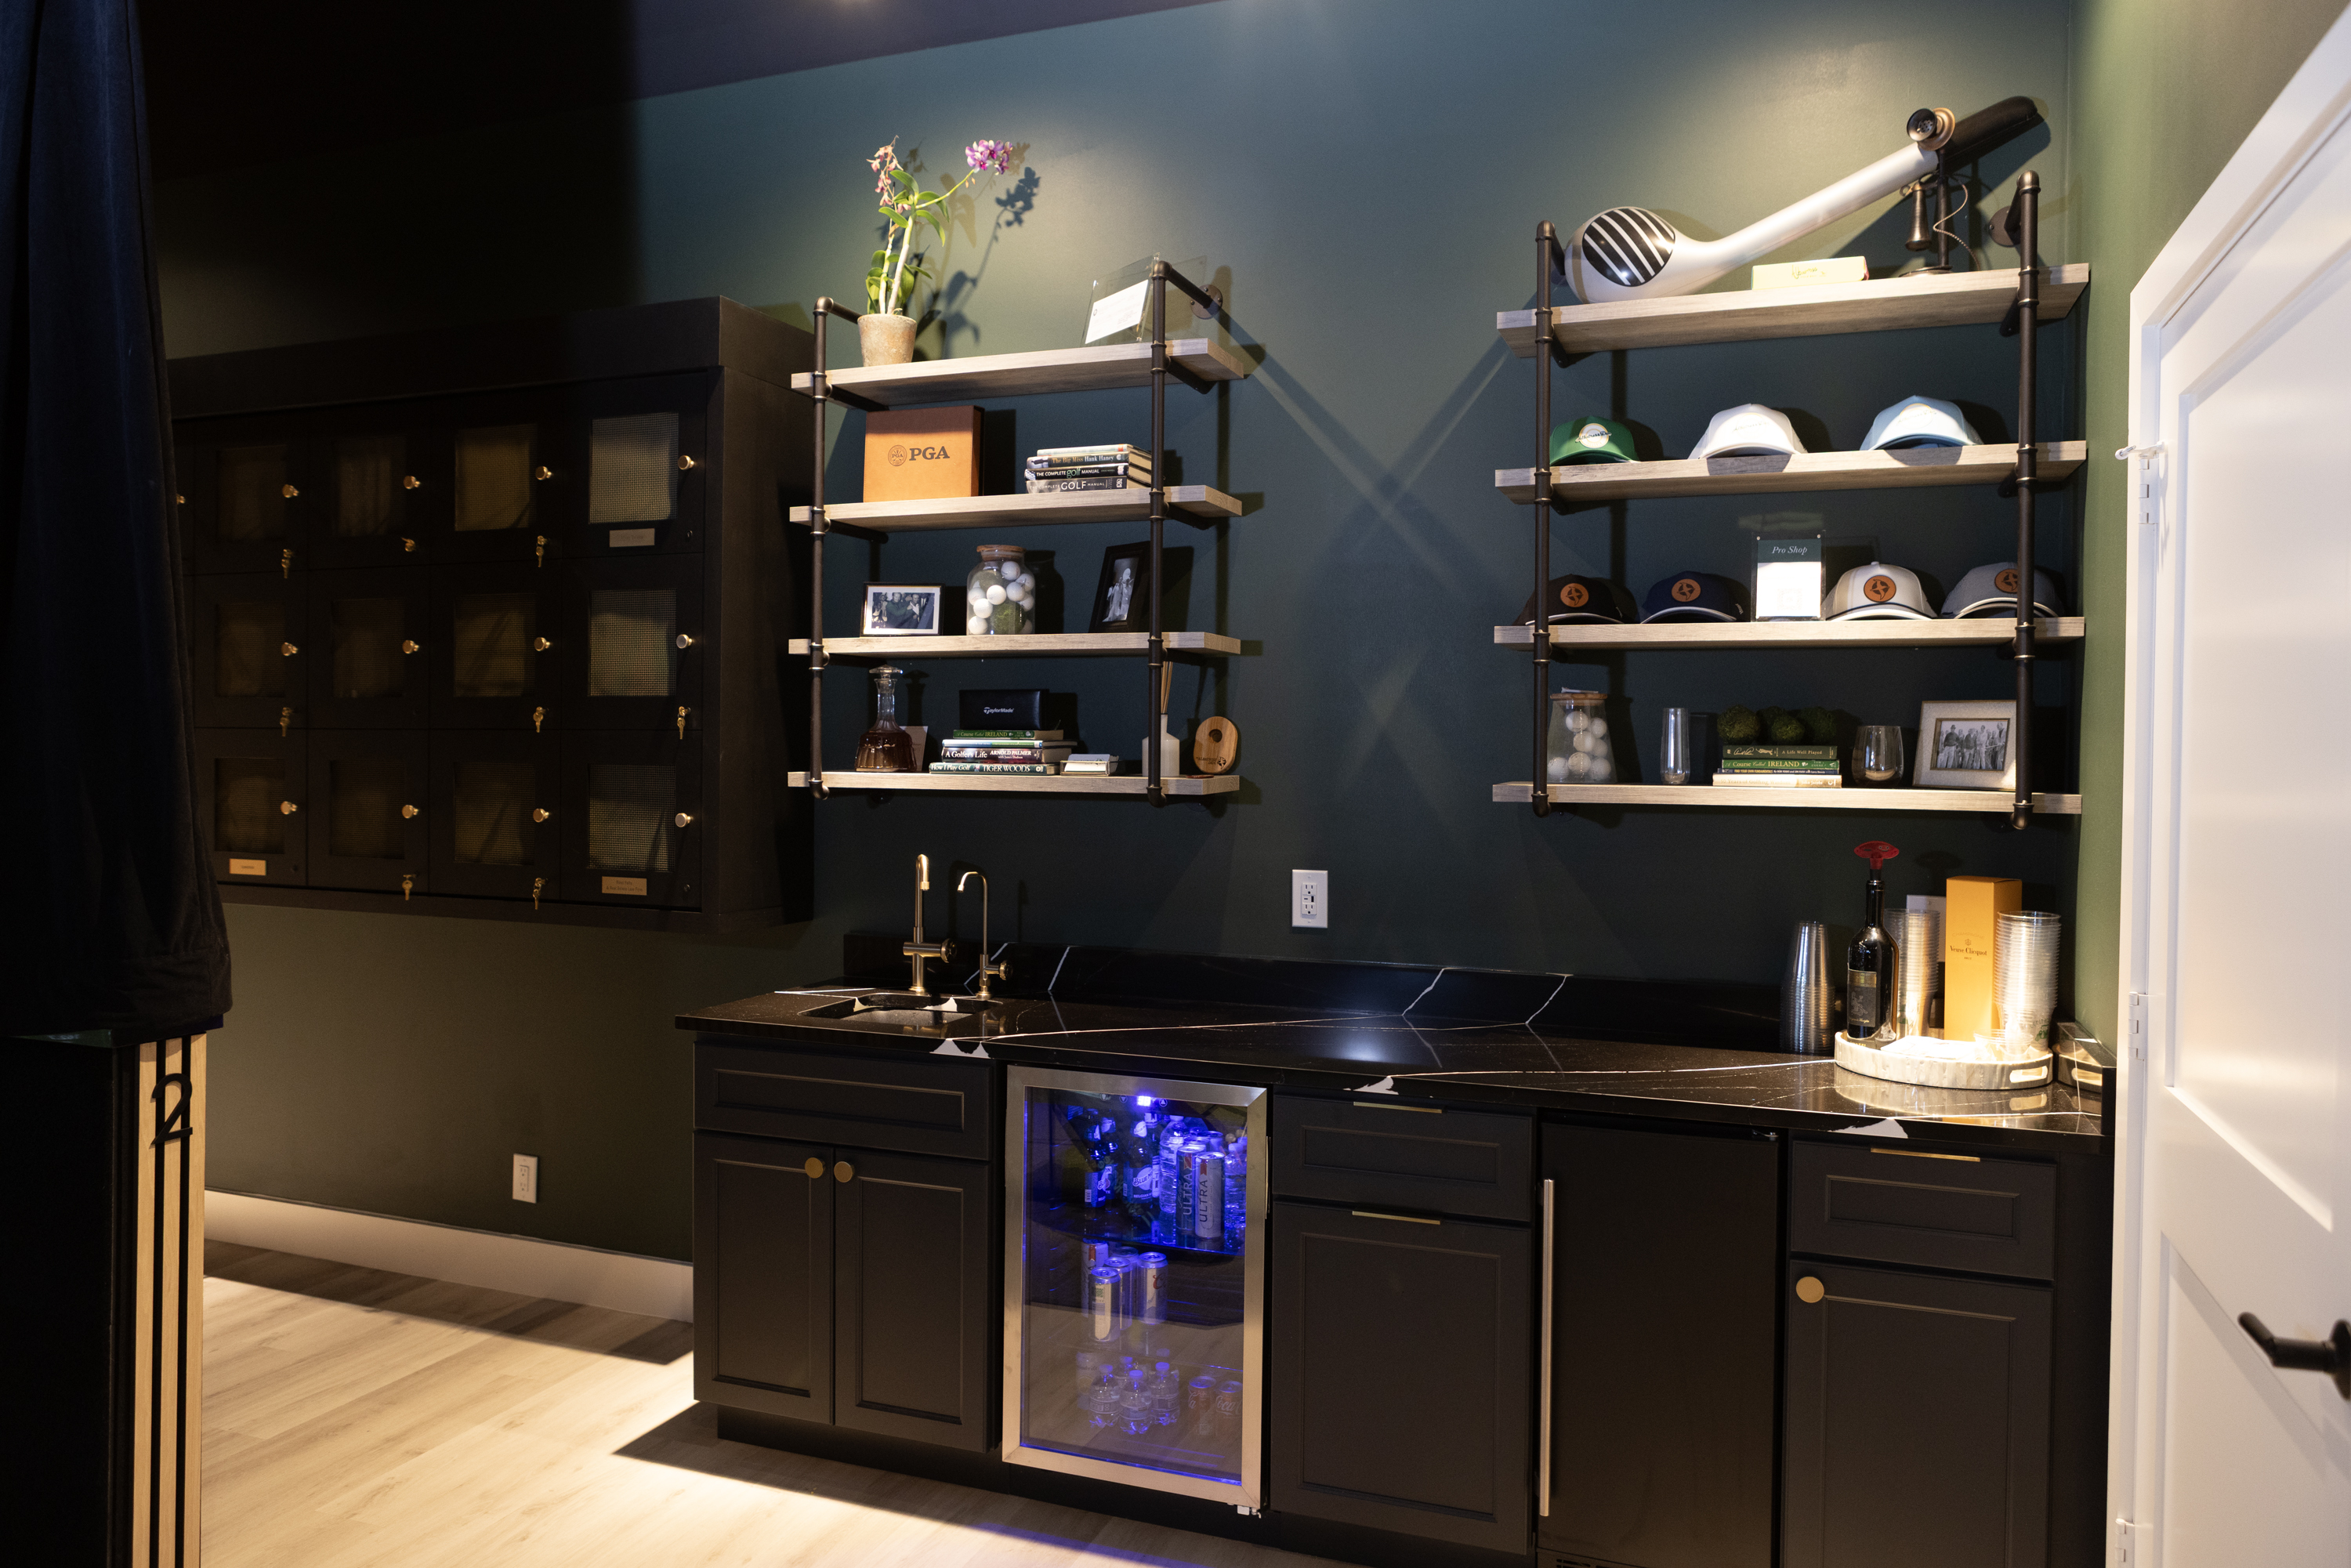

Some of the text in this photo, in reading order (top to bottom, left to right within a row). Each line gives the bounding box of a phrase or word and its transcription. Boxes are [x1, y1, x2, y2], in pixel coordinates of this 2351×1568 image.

[909, 446, 951, 461] PGA
[1067, 468, 1081, 479] golf
[1060, 480, 1087, 490] GOLF
[1788, 545, 1808, 556] Shop
[1965, 947, 1987, 956] Clicquot
[151, 1073, 194, 1145] 2
[1183, 1172, 1193, 1215] ULTRA
[1199, 1179, 1208, 1222] ULTRA
